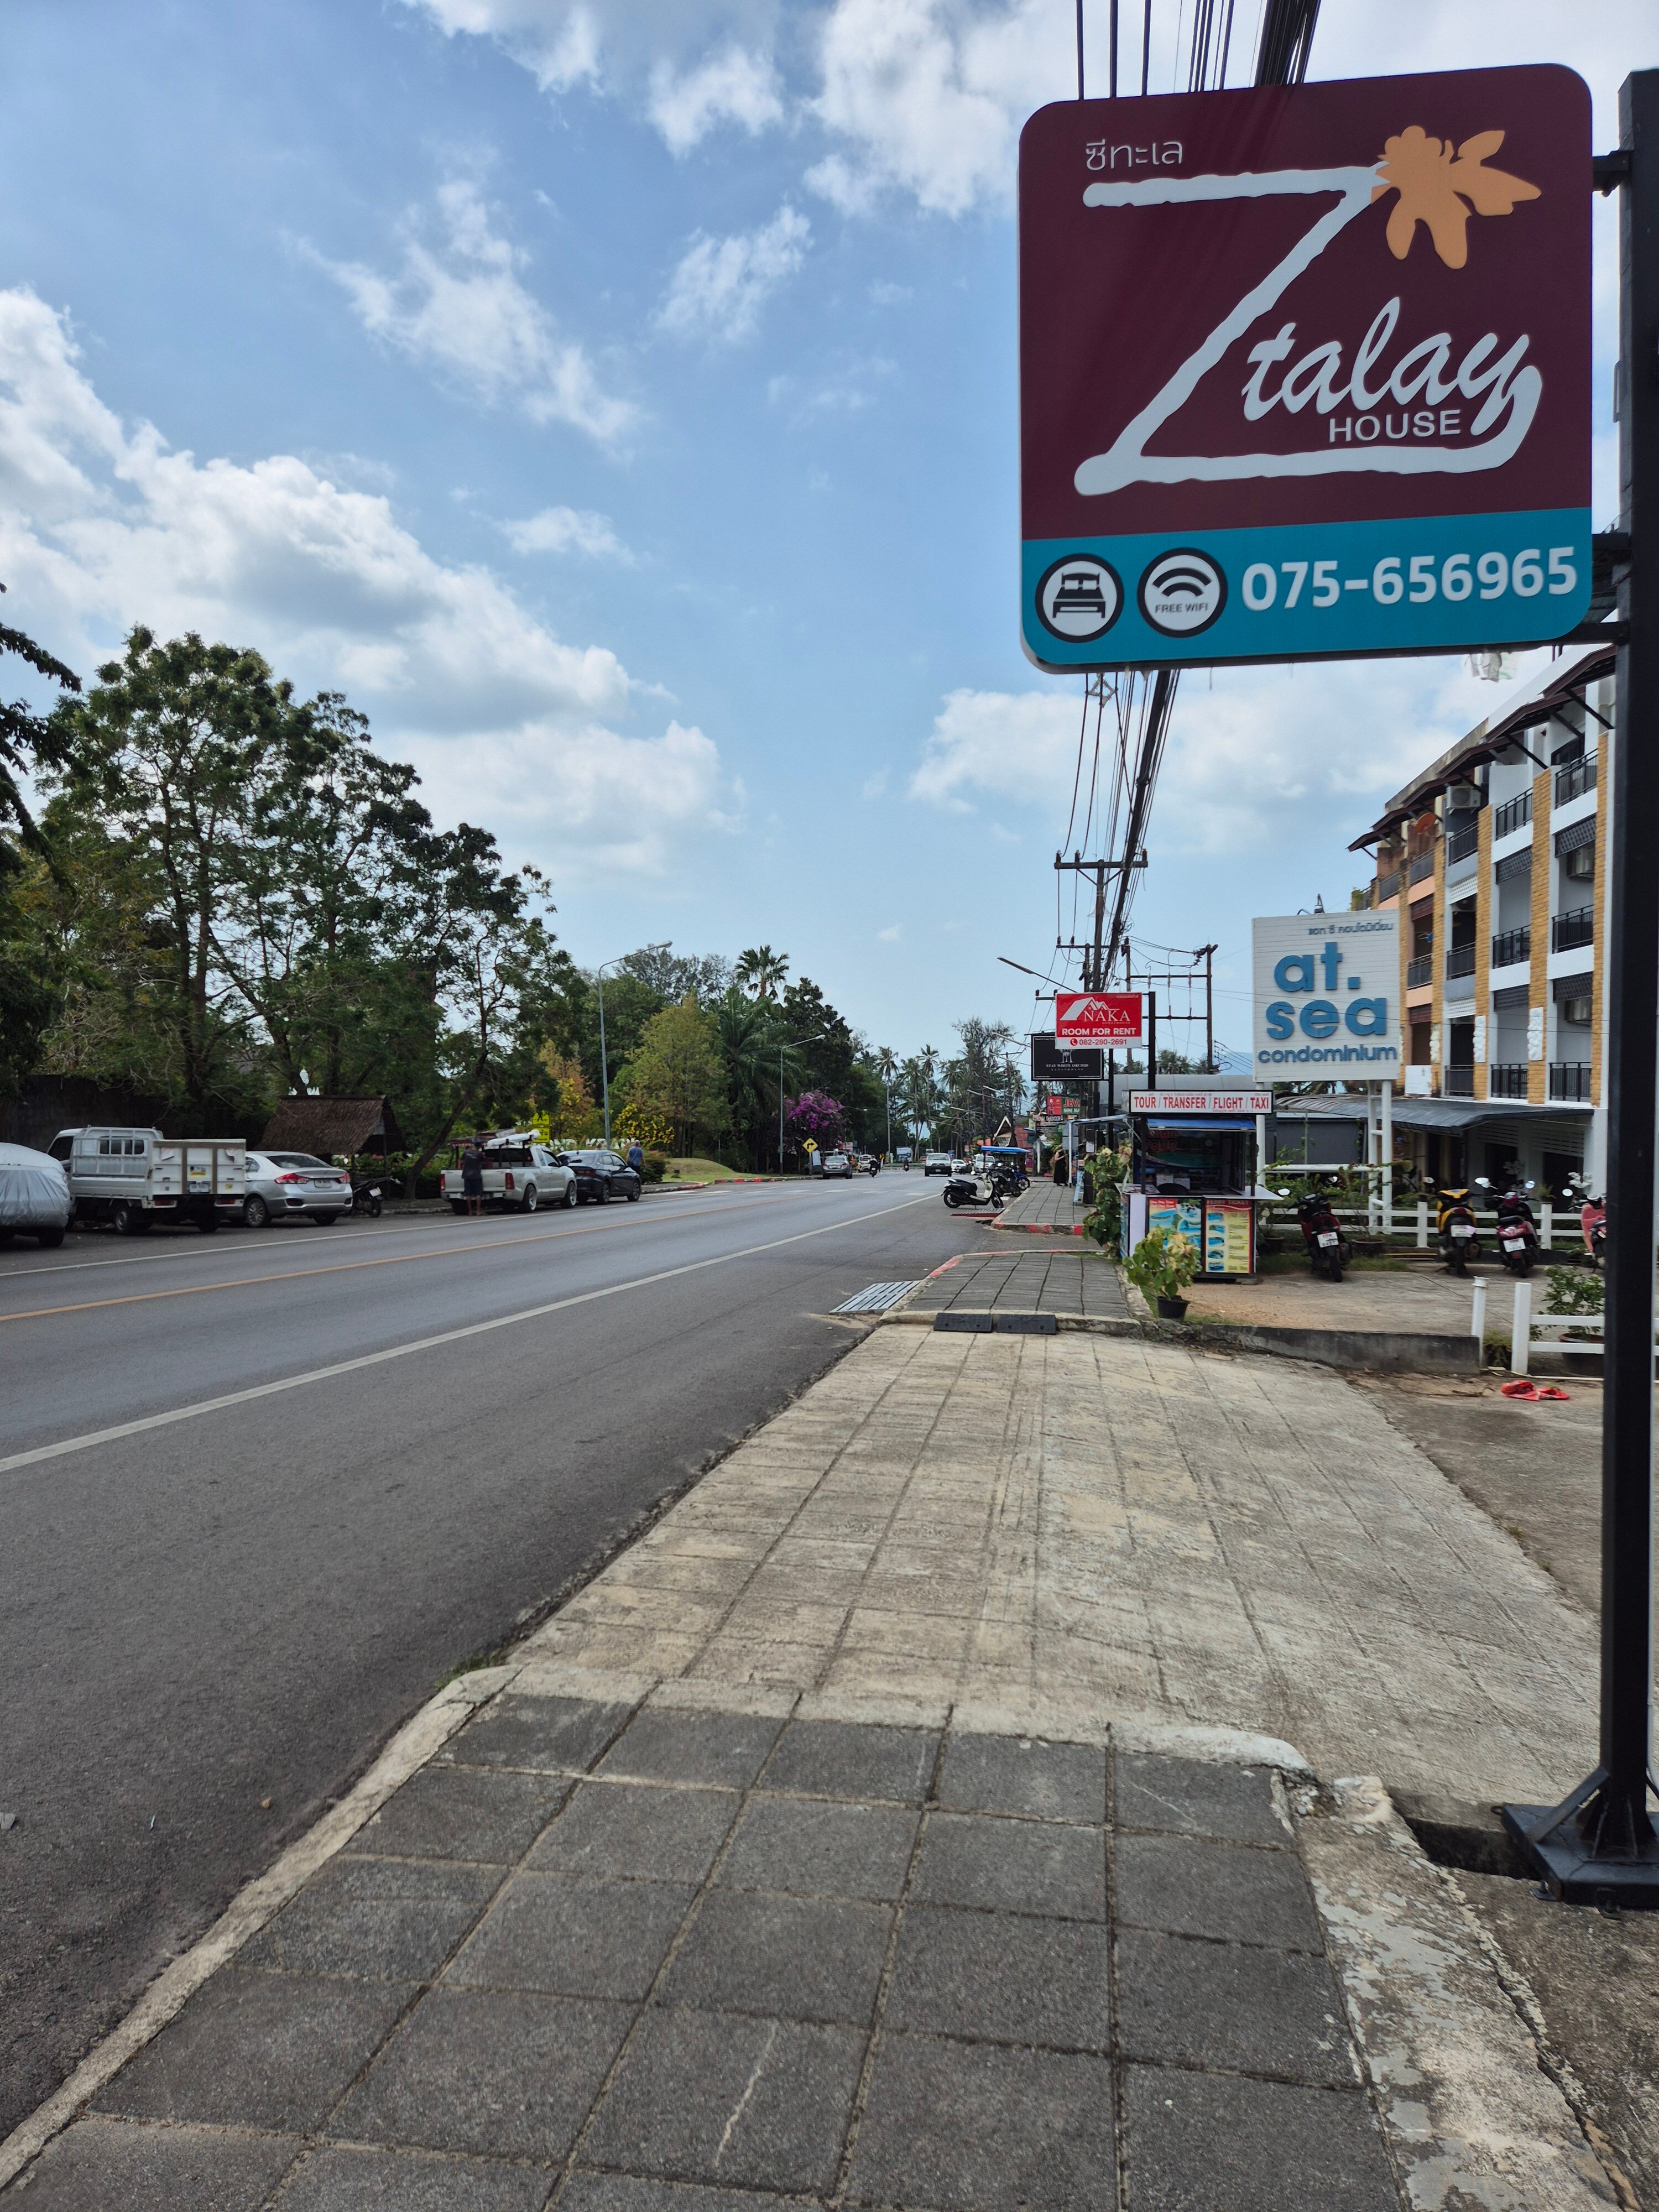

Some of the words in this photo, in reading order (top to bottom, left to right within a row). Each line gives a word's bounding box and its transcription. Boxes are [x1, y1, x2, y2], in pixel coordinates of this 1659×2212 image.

[1086, 139, 1183, 171] ซีทะเล
[1329, 410, 1460, 442] HOUSE
[1241, 546, 1577, 612] 075-656965
[1155, 603, 1182, 613] FREE
[1185, 602, 1208, 612] WIFI
[1274, 942, 1361, 992] at.
[1084, 1010, 1131, 1022] NAKA
[1266, 998, 1387, 1040] sea
[1258, 1044, 1397, 1063] condominium
[1134, 1097, 1156, 1108] TOUR
[1163, 1097, 1206, 1109] TRANSFER
[1213, 1097, 1243, 1109] FLIGHT
[1250, 1097, 1269, 1109] TAXI
